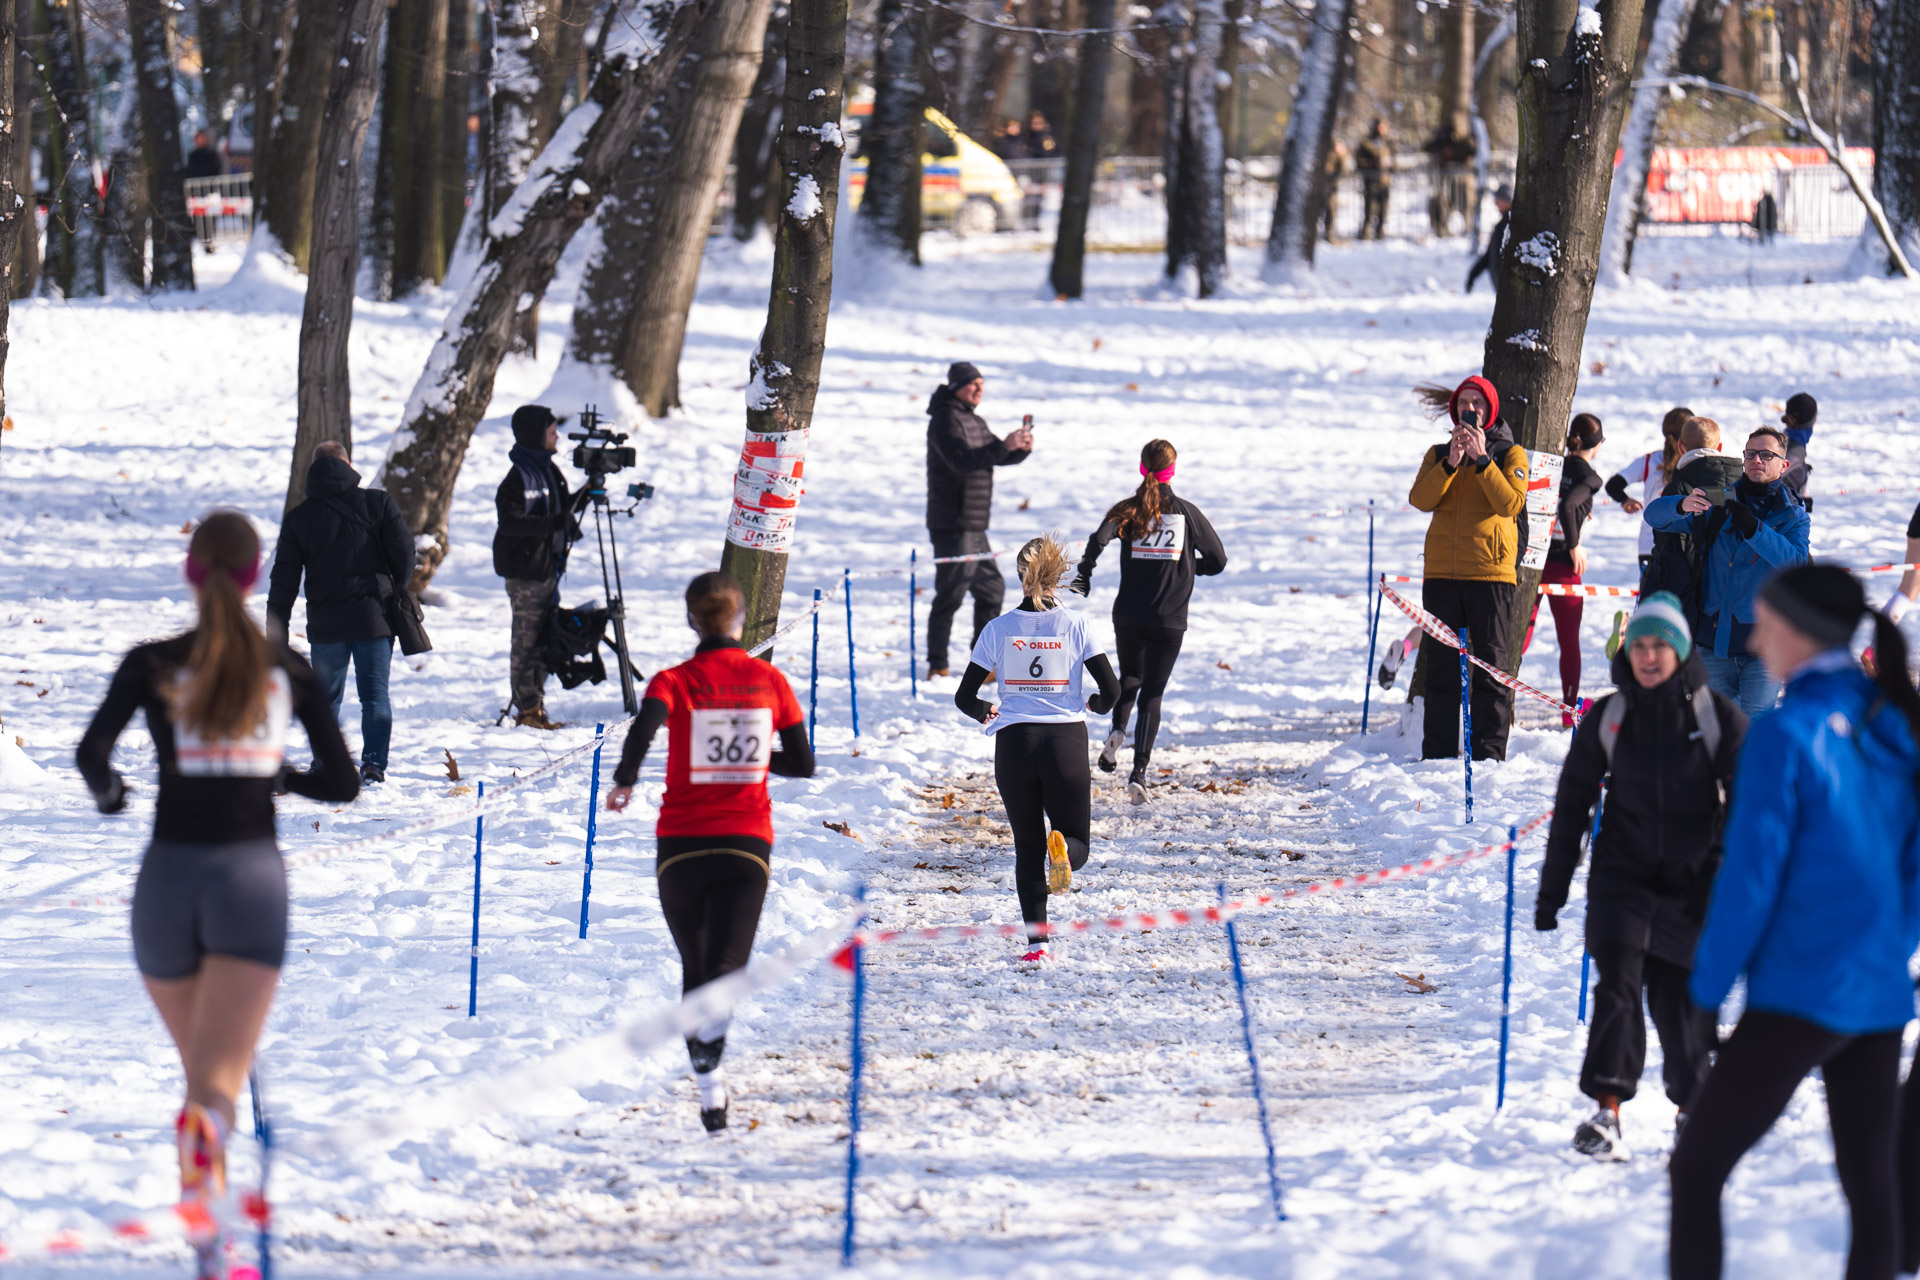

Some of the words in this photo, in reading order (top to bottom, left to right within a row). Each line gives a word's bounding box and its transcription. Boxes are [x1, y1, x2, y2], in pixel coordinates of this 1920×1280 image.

[1029, 641, 1062, 650] ORLEN
[1028, 655, 1044, 679] 6
[707, 734, 760, 764] 362
